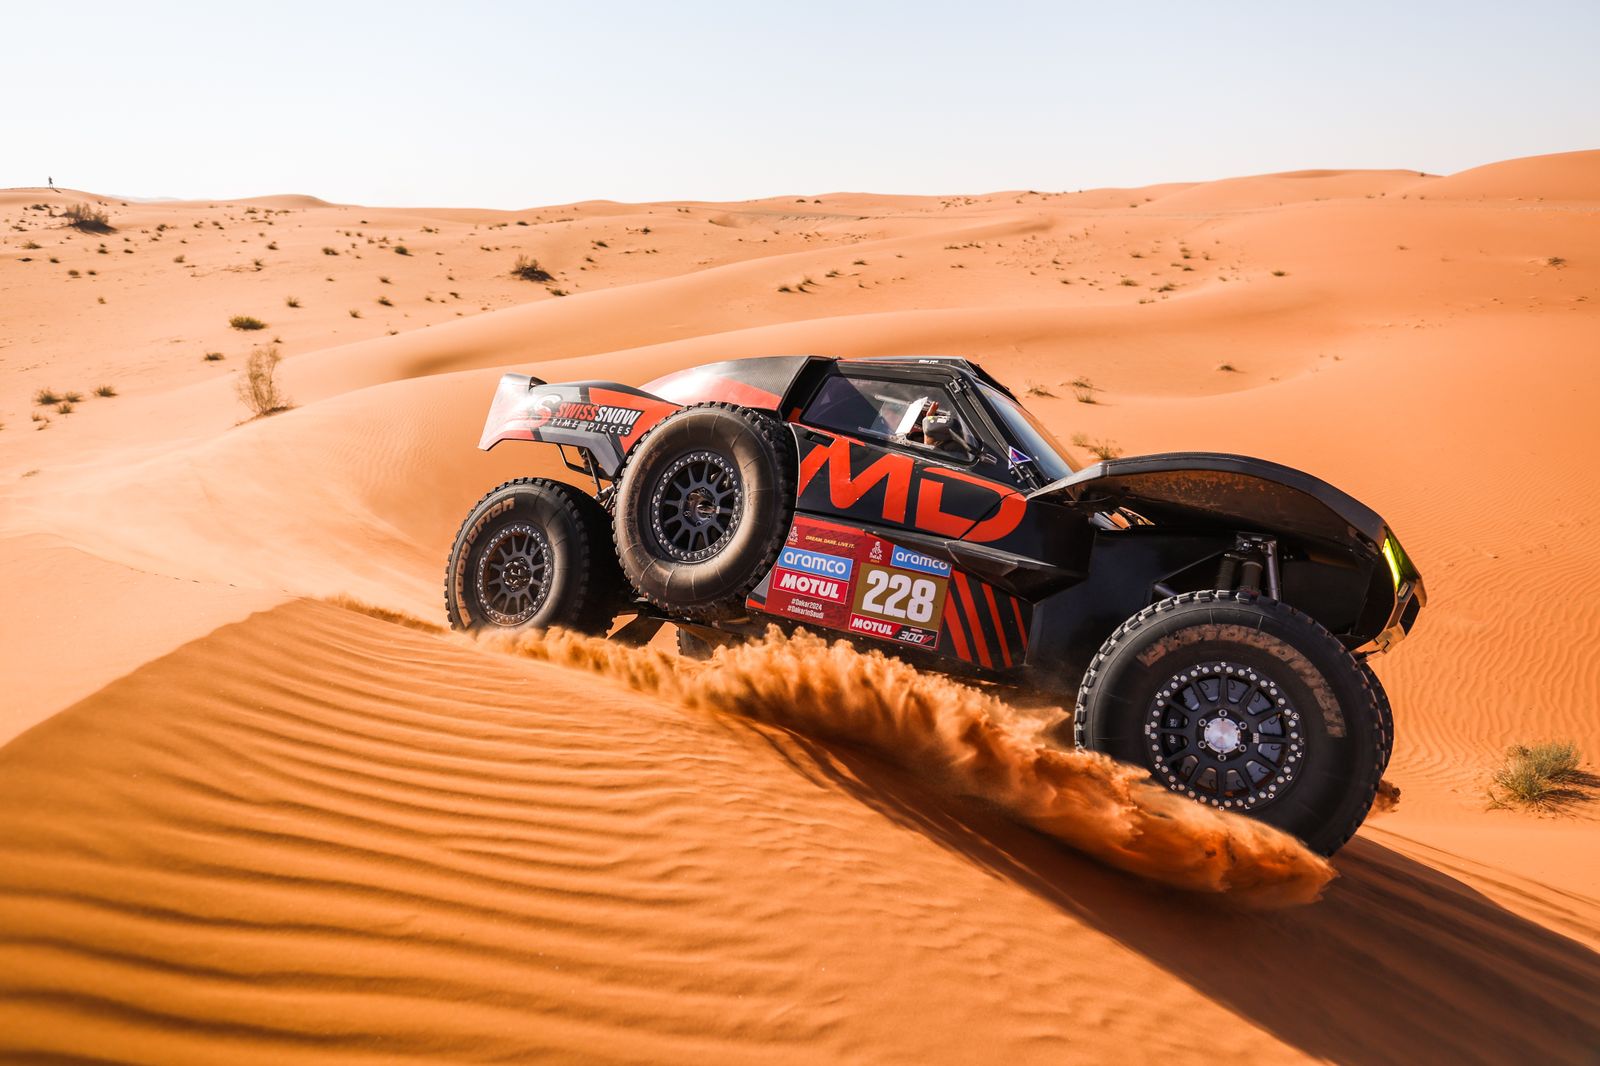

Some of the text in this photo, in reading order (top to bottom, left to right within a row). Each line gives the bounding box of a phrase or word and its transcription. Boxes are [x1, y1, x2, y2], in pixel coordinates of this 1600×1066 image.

[556, 402, 641, 425] SWISSSNOW
[551, 418, 631, 435] TIME PIECES
[784, 551, 846, 575] aramco
[896, 552, 948, 570] aramco
[780, 573, 839, 599] MOTUL
[862, 569, 937, 623] 228
[791, 598, 822, 611] #Dakar2024
[852, 617, 893, 635] MOTUL
